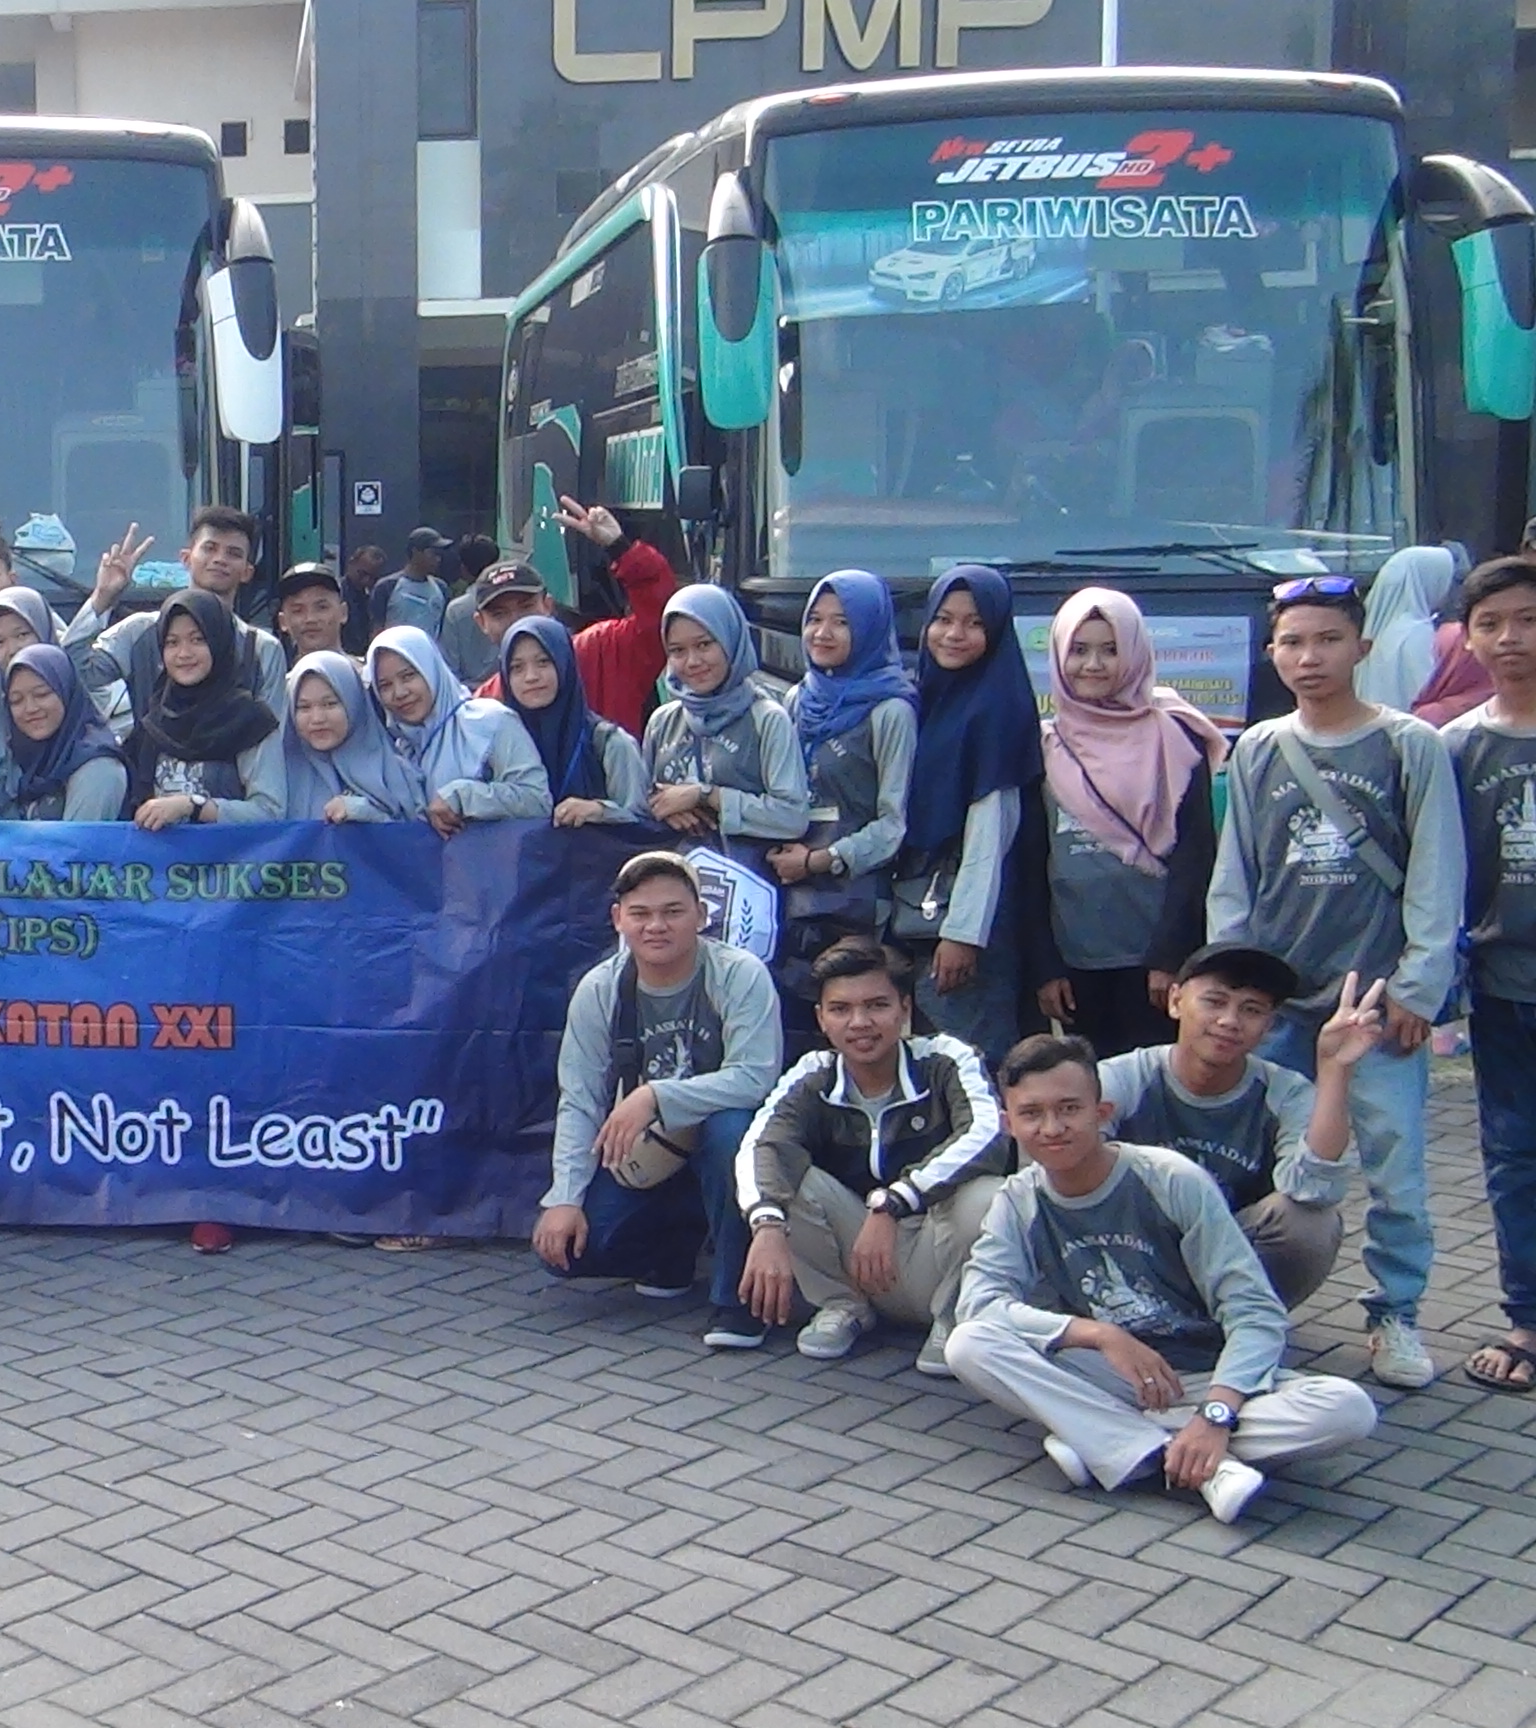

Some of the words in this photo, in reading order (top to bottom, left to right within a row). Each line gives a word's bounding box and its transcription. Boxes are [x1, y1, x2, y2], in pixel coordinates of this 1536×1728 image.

[936, 152, 1127, 184] JETBUS
[914, 196, 1258, 242] PARIWISATA
[165, 861, 349, 902] SUKSES
[150, 1003, 236, 1050] XXI
[50, 1090, 193, 1167] Not
[206, 1095, 444, 1172] Least"
